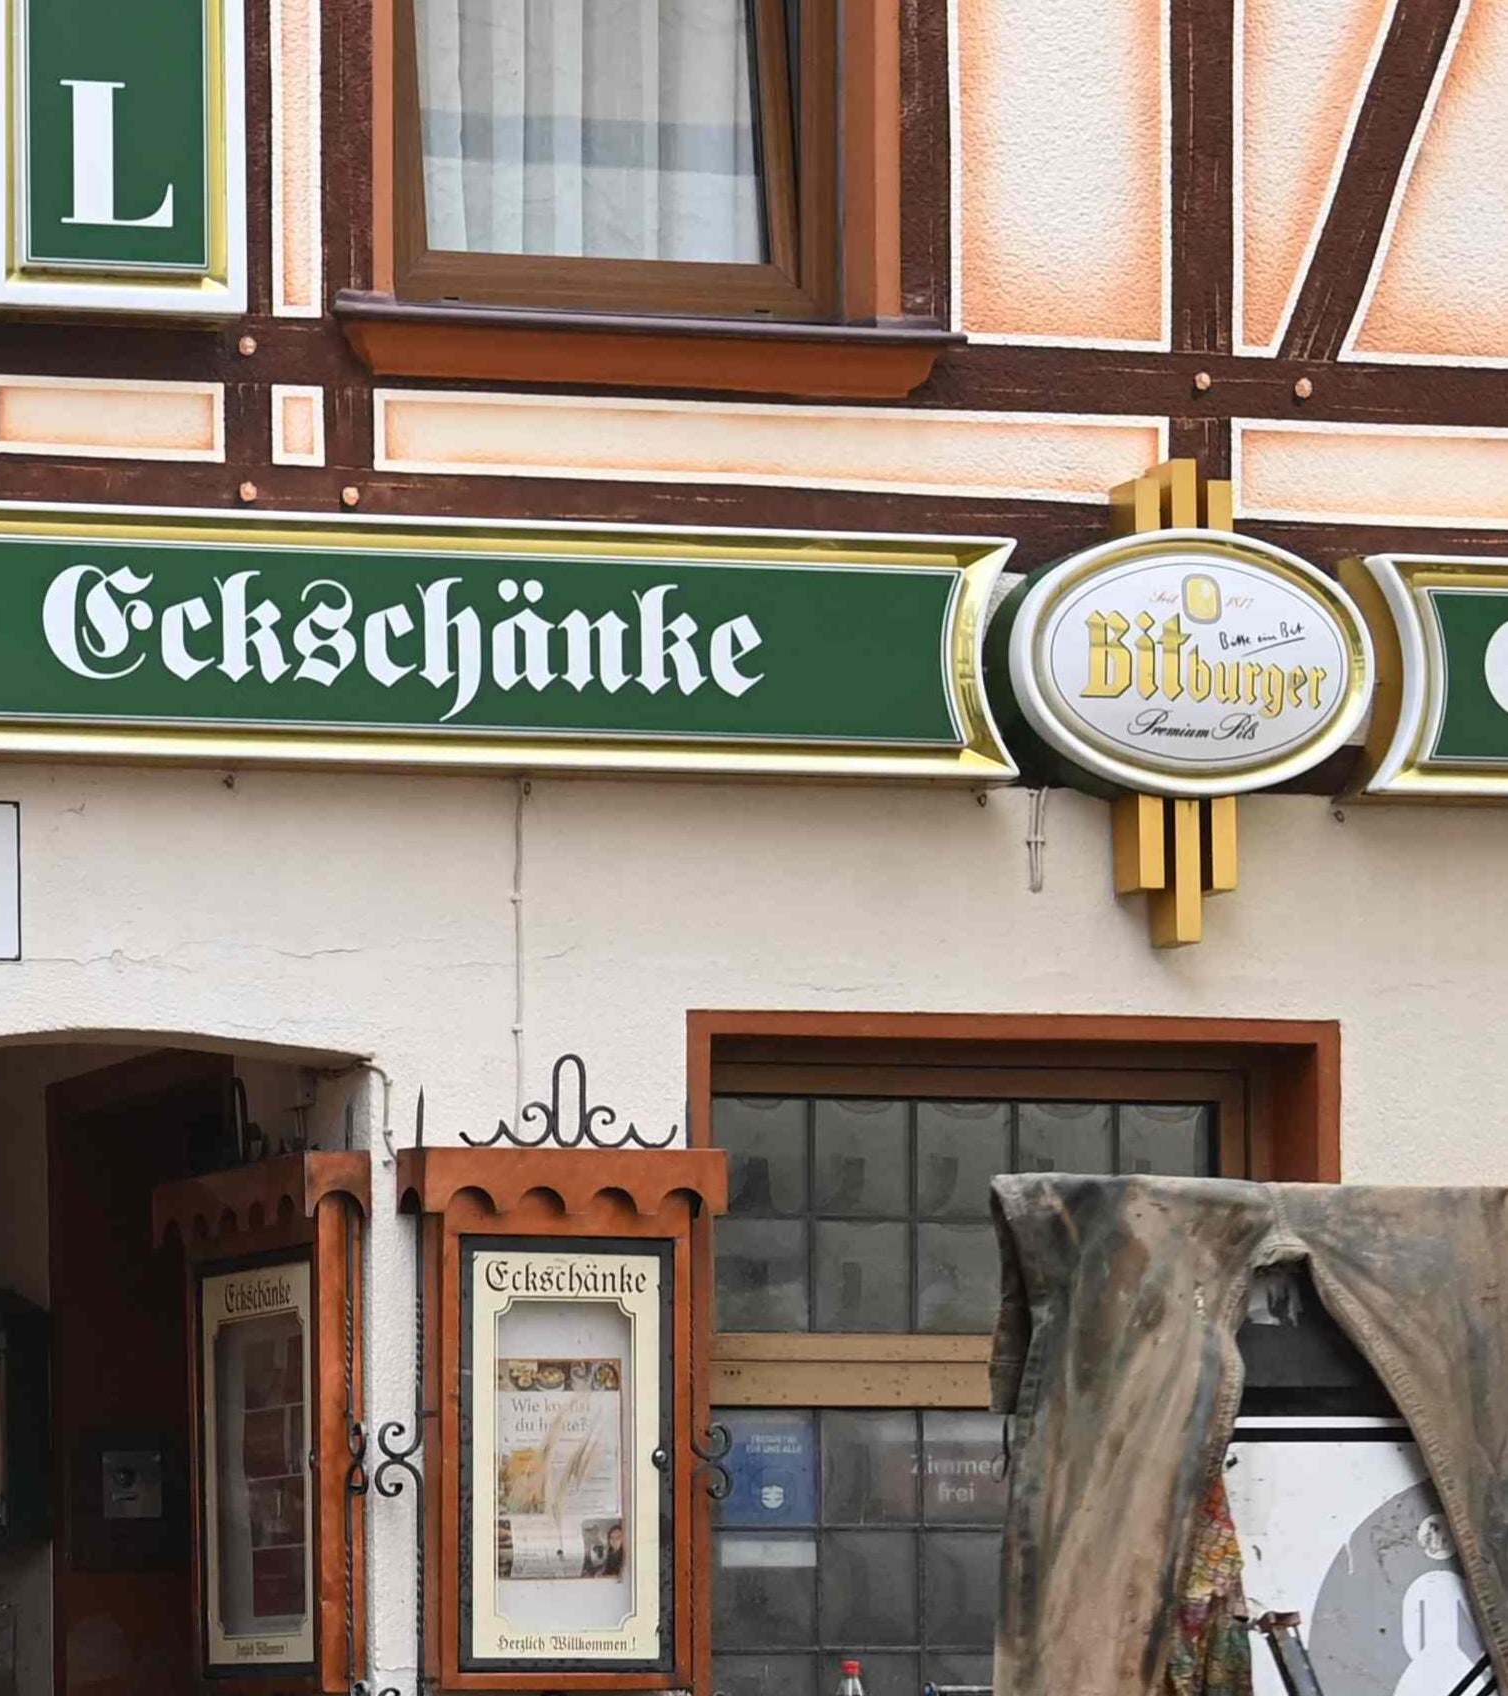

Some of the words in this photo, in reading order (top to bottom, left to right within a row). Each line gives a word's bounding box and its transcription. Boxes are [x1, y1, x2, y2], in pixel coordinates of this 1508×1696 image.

[1280, 621, 1305, 639] Bit
[42, 563, 765, 722] Eckschänke
[1080, 610, 1327, 718] Bitburger
[1128, 709, 1212, 740] Premium
[1211, 713, 1259, 740] Pils
[485, 1260, 647, 1297] Eckschänke
[511, 1398, 541, 1413] Wie
[514, 1417, 534, 1432] du
[938, 1481, 975, 1502] frei
[496, 1635, 545, 1653] Herzlich
[549, 1635, 628, 1651] Willkommen
